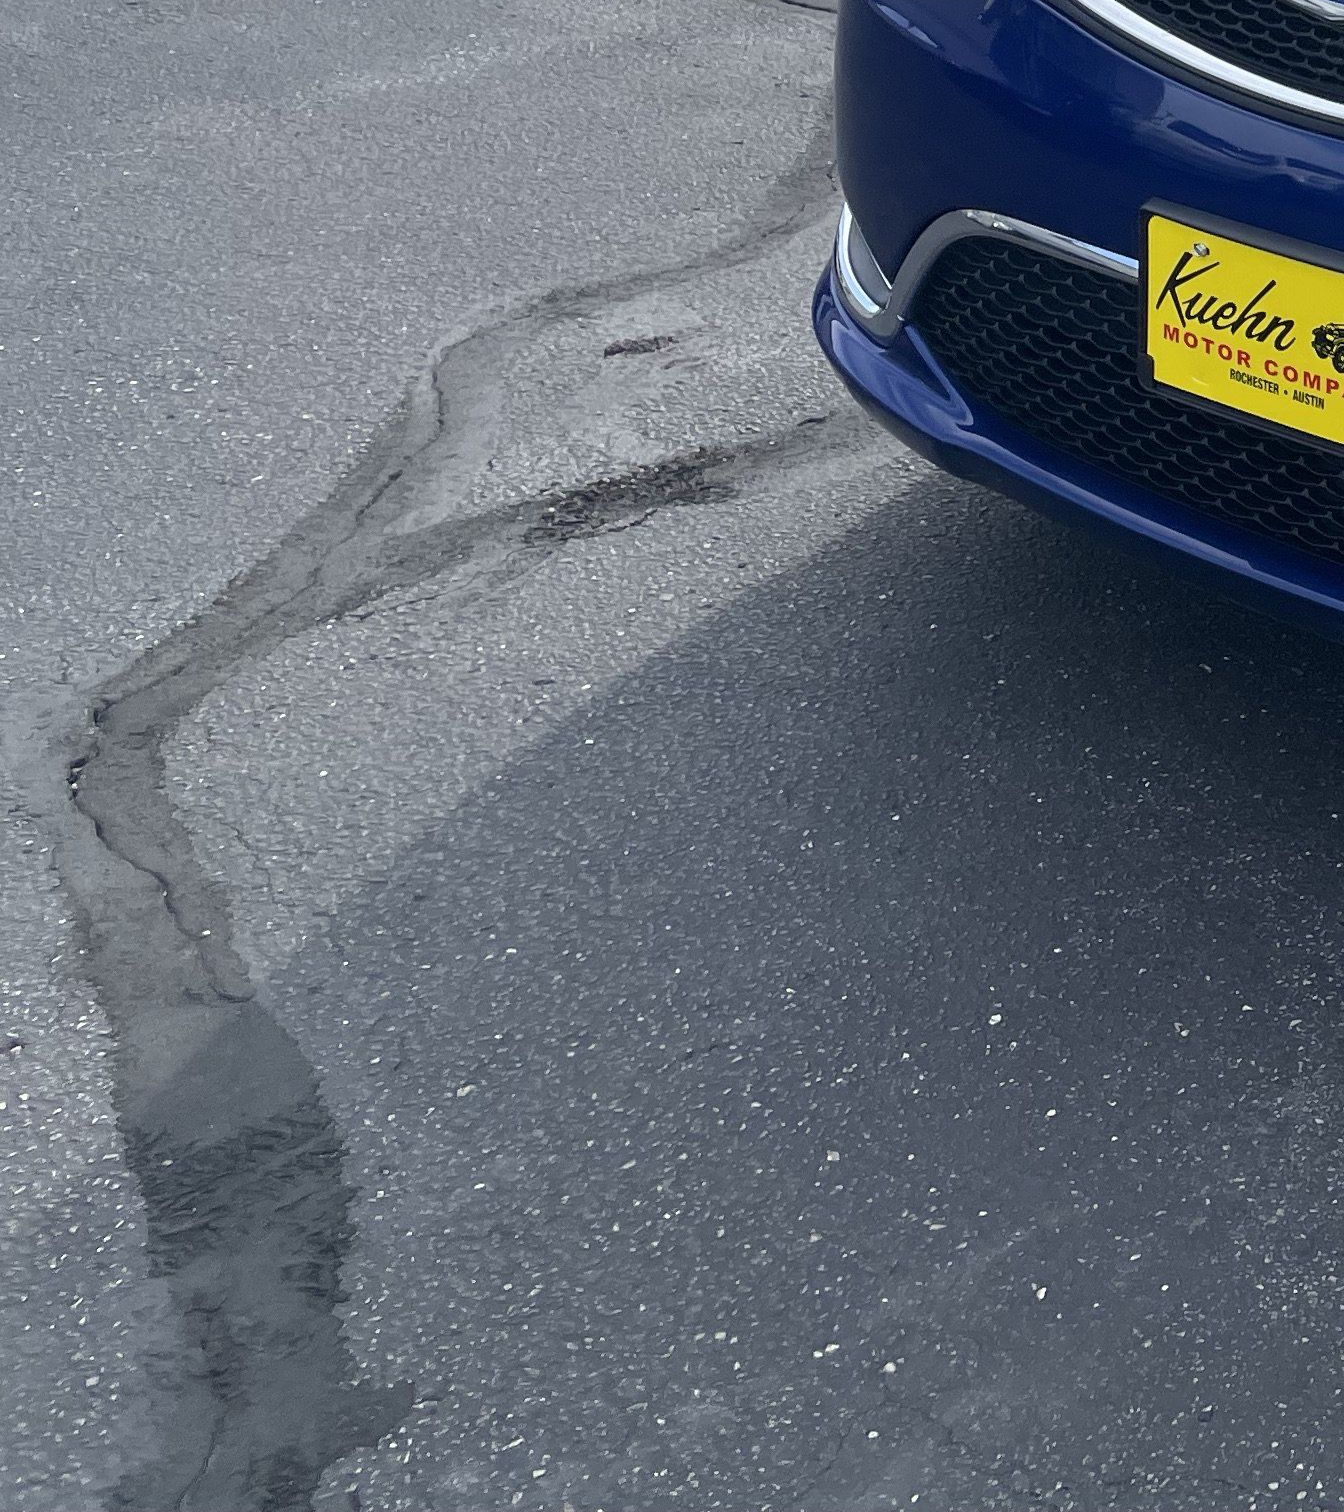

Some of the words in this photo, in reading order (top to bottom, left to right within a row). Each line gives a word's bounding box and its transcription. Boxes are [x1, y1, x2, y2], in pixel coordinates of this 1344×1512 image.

[1156, 251, 1297, 351] Kuehn
[1163, 323, 1252, 368] MOTOR
[1229, 367, 1280, 396] ROCHESTER
[1292, 389, 1325, 410] AUSTIN
